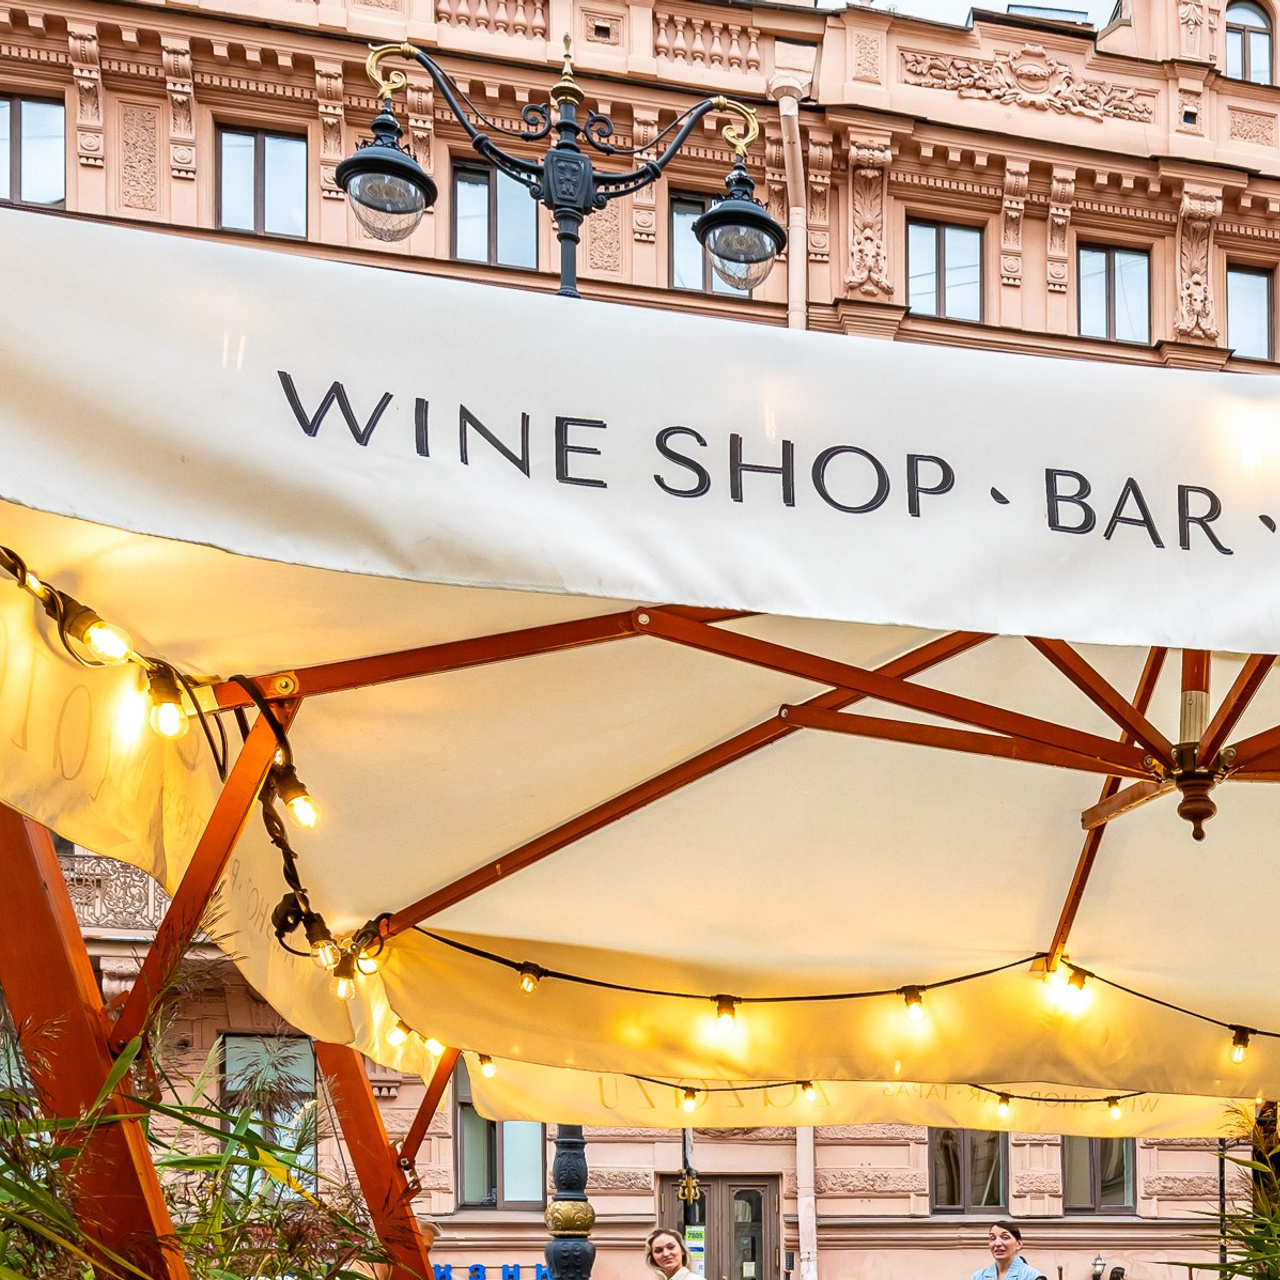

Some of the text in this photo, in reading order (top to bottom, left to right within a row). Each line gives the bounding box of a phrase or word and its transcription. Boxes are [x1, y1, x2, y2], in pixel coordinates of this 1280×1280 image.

[276, 369, 608, 490] WINE
[653, 425, 955, 518] SHOP
[1045, 467, 1234, 556] BAR
